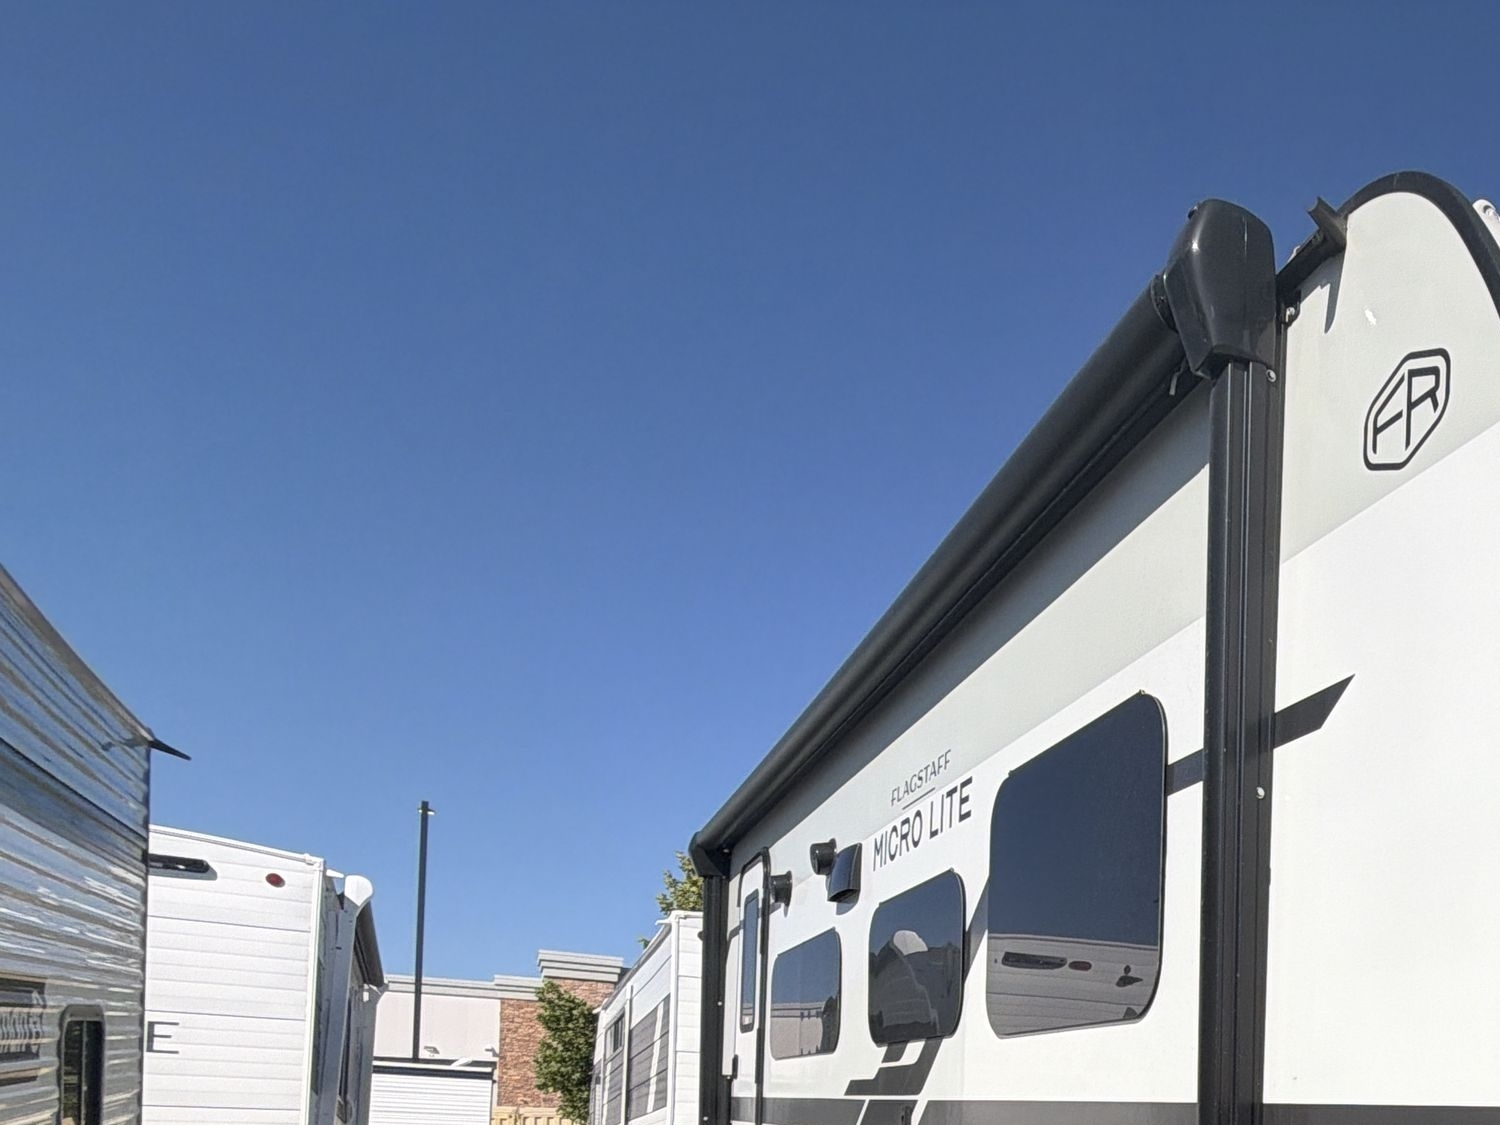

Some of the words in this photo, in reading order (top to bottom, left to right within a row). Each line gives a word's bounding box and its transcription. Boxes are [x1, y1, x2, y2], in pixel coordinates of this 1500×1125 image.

[890, 748, 952, 807] FLAGSTAFF
[872, 809, 923, 872] MICRO
[929, 775, 973, 839] LITE
